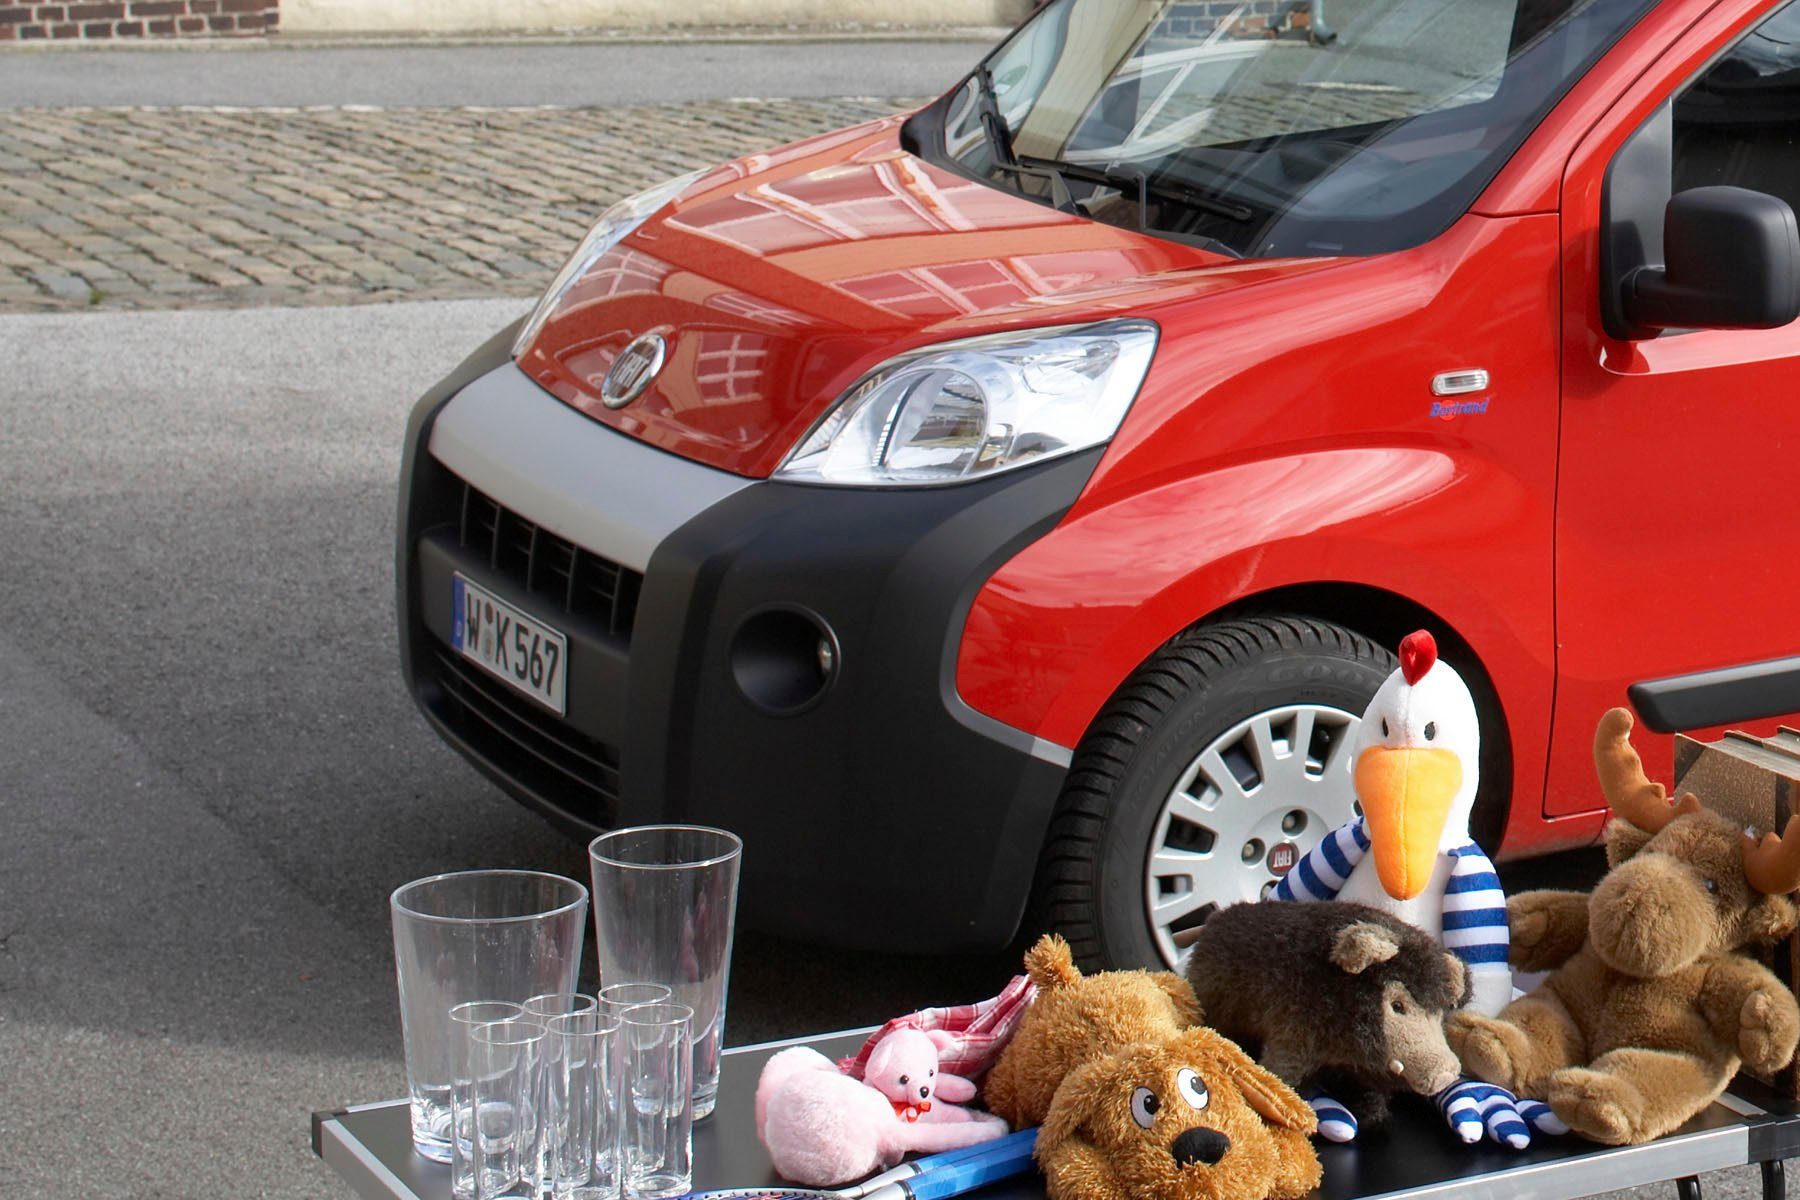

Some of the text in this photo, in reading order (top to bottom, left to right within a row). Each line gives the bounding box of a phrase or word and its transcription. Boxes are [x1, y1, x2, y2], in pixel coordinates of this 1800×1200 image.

[467, 593, 559, 697] W K 567
[1272, 850, 1292, 868] FIAT
